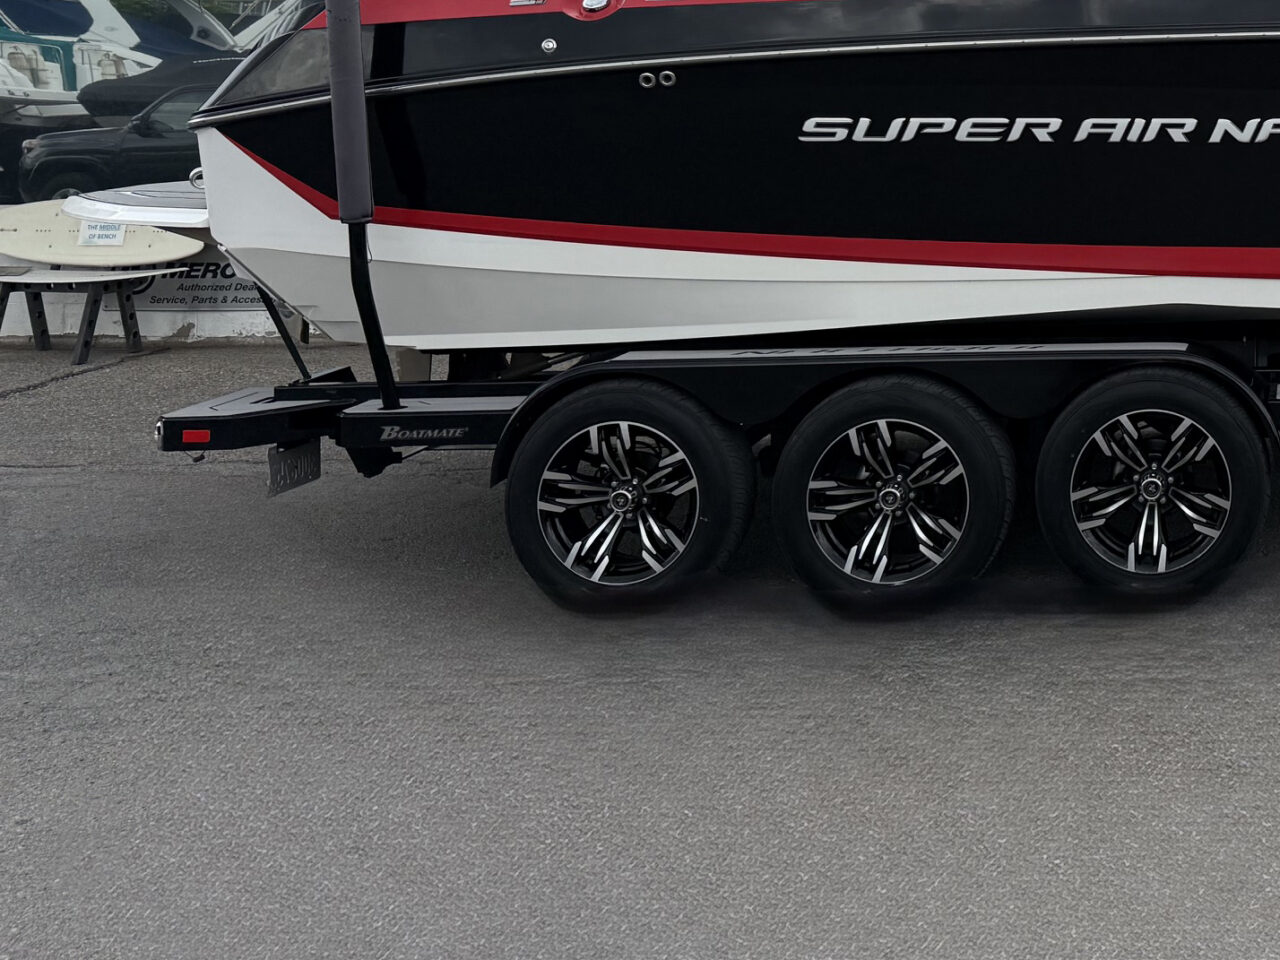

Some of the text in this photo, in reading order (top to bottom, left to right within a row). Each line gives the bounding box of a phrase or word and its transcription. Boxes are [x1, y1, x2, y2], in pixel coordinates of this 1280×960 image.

[798, 117, 1063, 142] SUPER
[1073, 117, 1198, 143] AIR
[160, 262, 237, 279] MERC
[176, 282, 232, 292] Authorized
[149, 295, 188, 305] Service,
[191, 295, 218, 304] Parts
[220, 295, 228, 304] &
